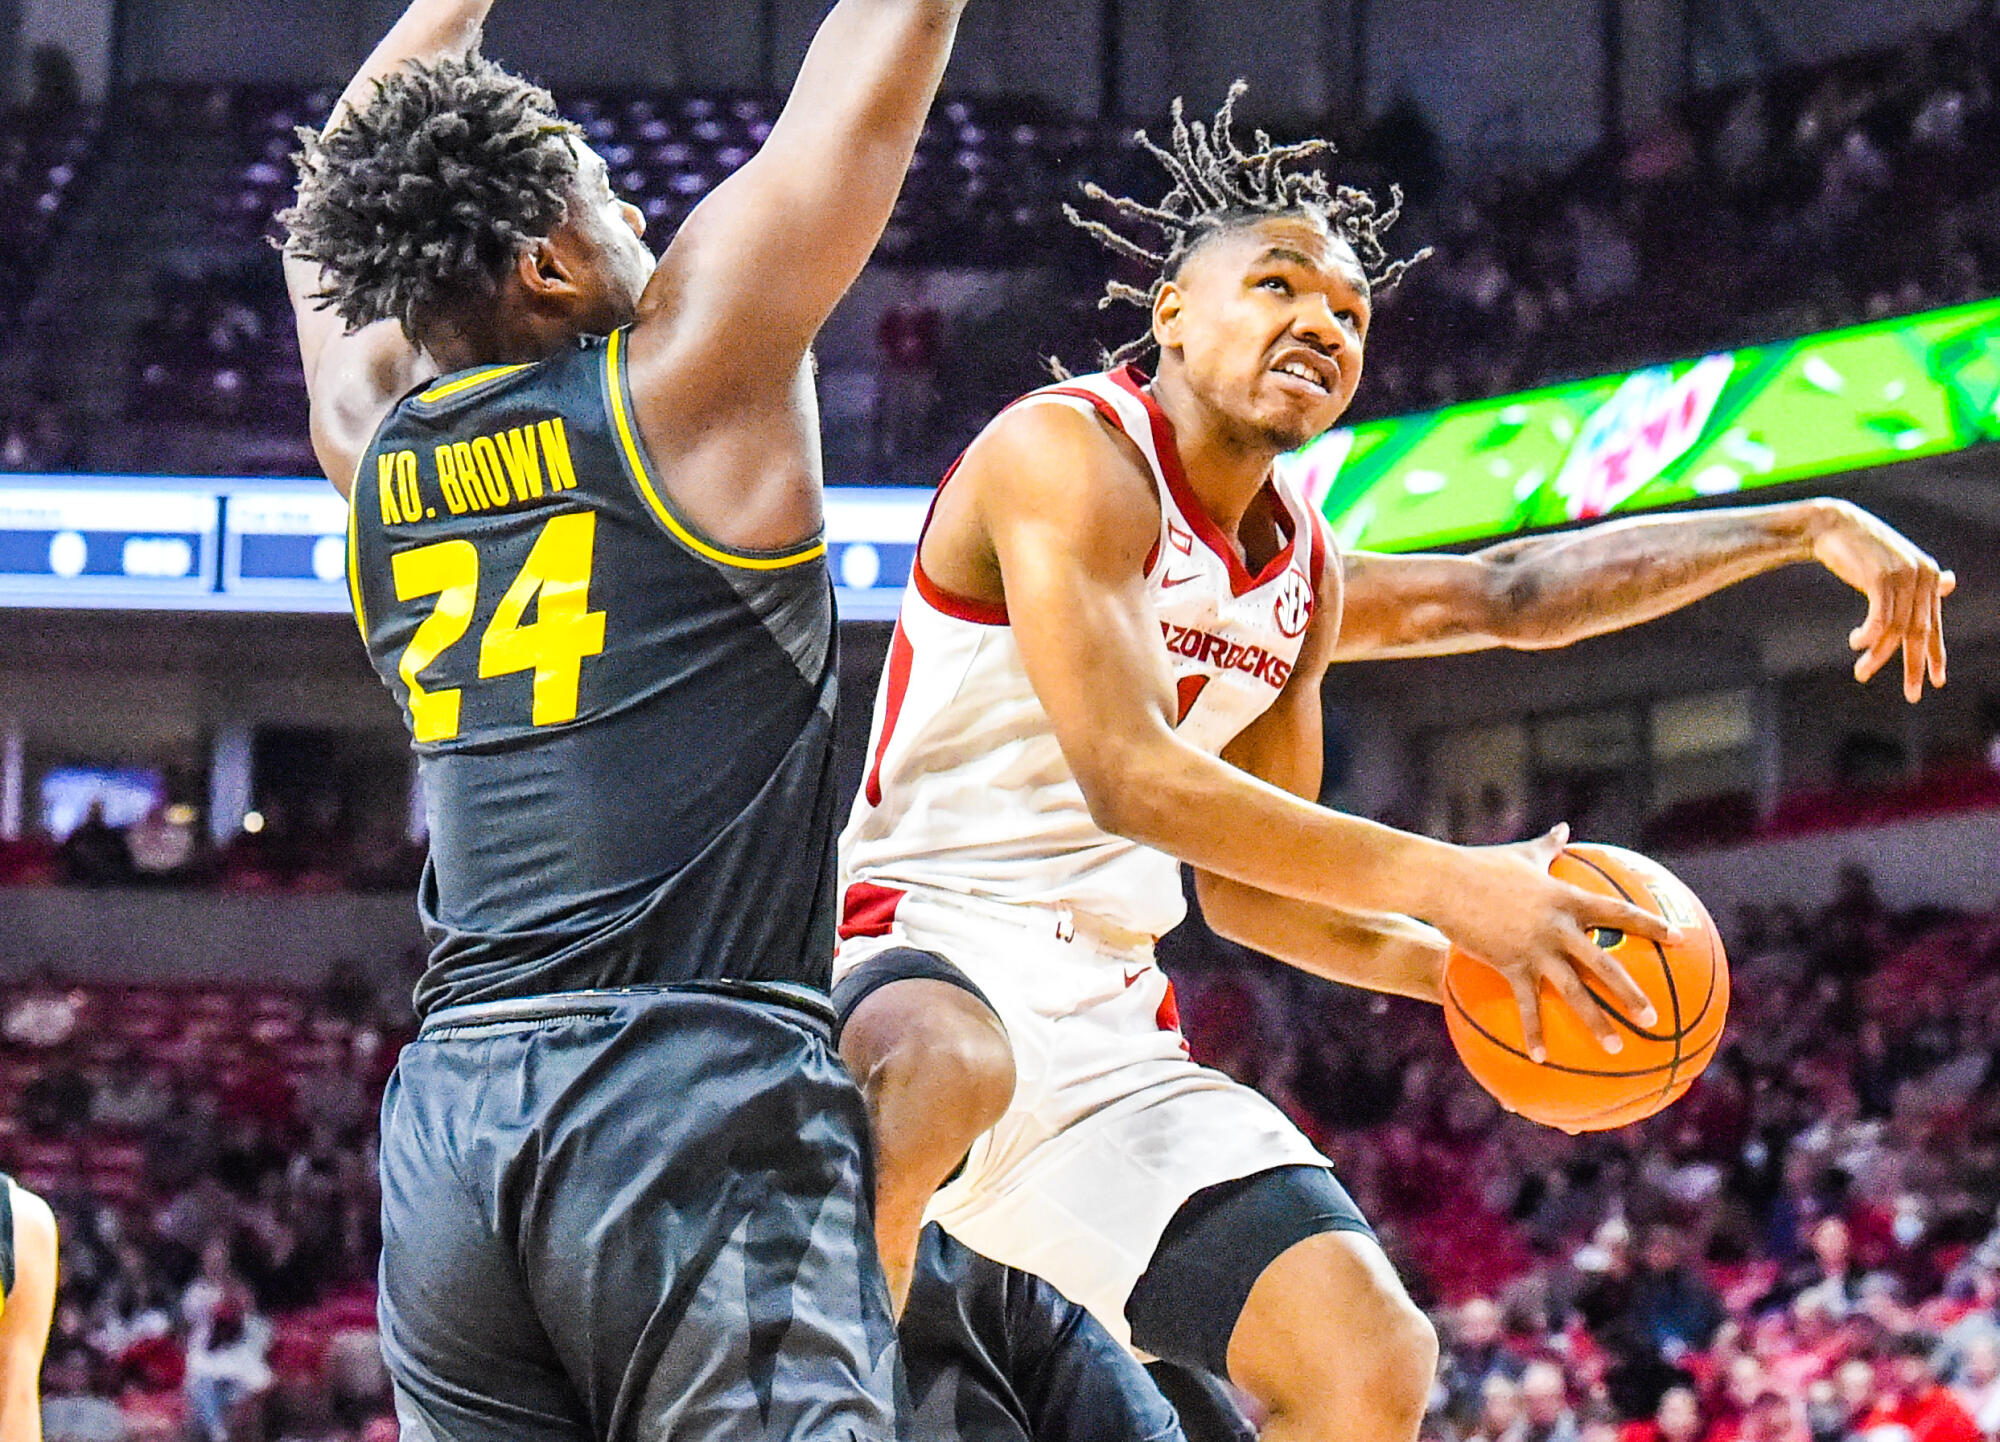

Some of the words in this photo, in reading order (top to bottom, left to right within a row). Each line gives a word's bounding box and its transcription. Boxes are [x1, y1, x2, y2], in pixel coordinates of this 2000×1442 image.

[378, 450, 436, 525] KO.
[434, 417, 577, 515] BROWN
[391, 510, 607, 743] 24
